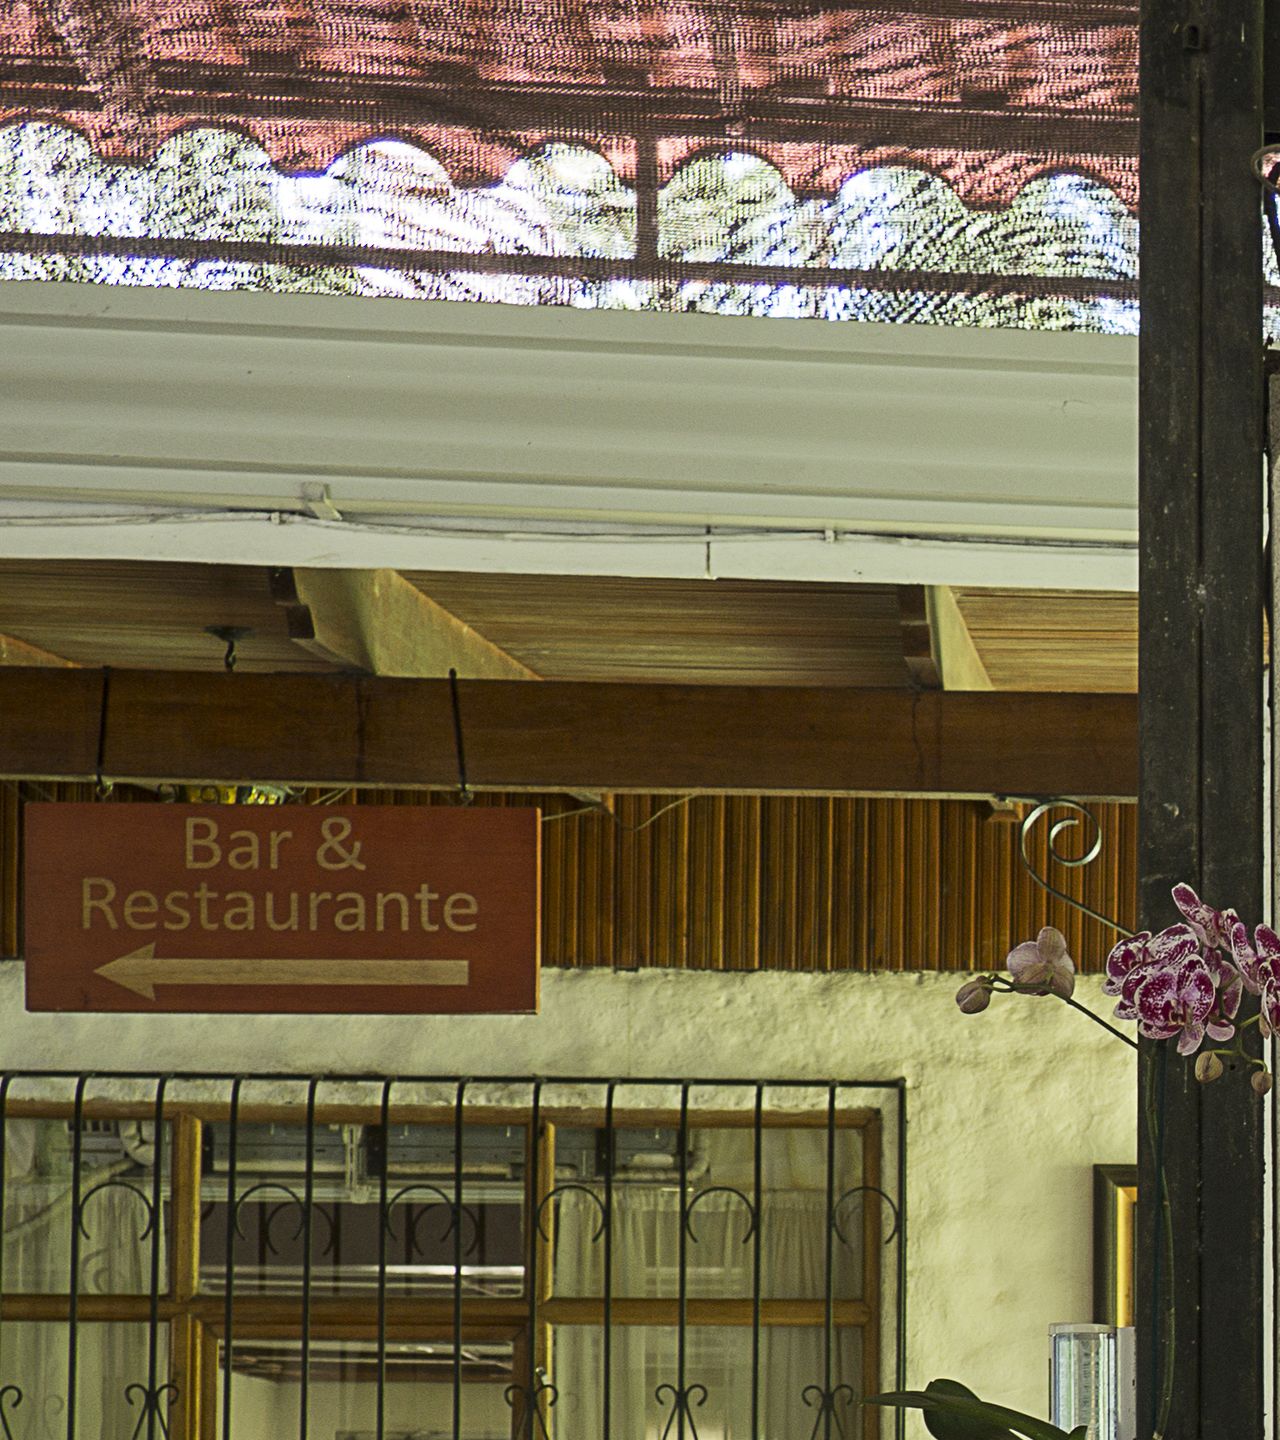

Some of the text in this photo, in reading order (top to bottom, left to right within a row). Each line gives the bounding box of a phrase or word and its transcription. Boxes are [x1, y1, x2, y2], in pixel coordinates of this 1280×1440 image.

[186, 818, 366, 871] Bar &
[84, 879, 478, 932] Restaurante
